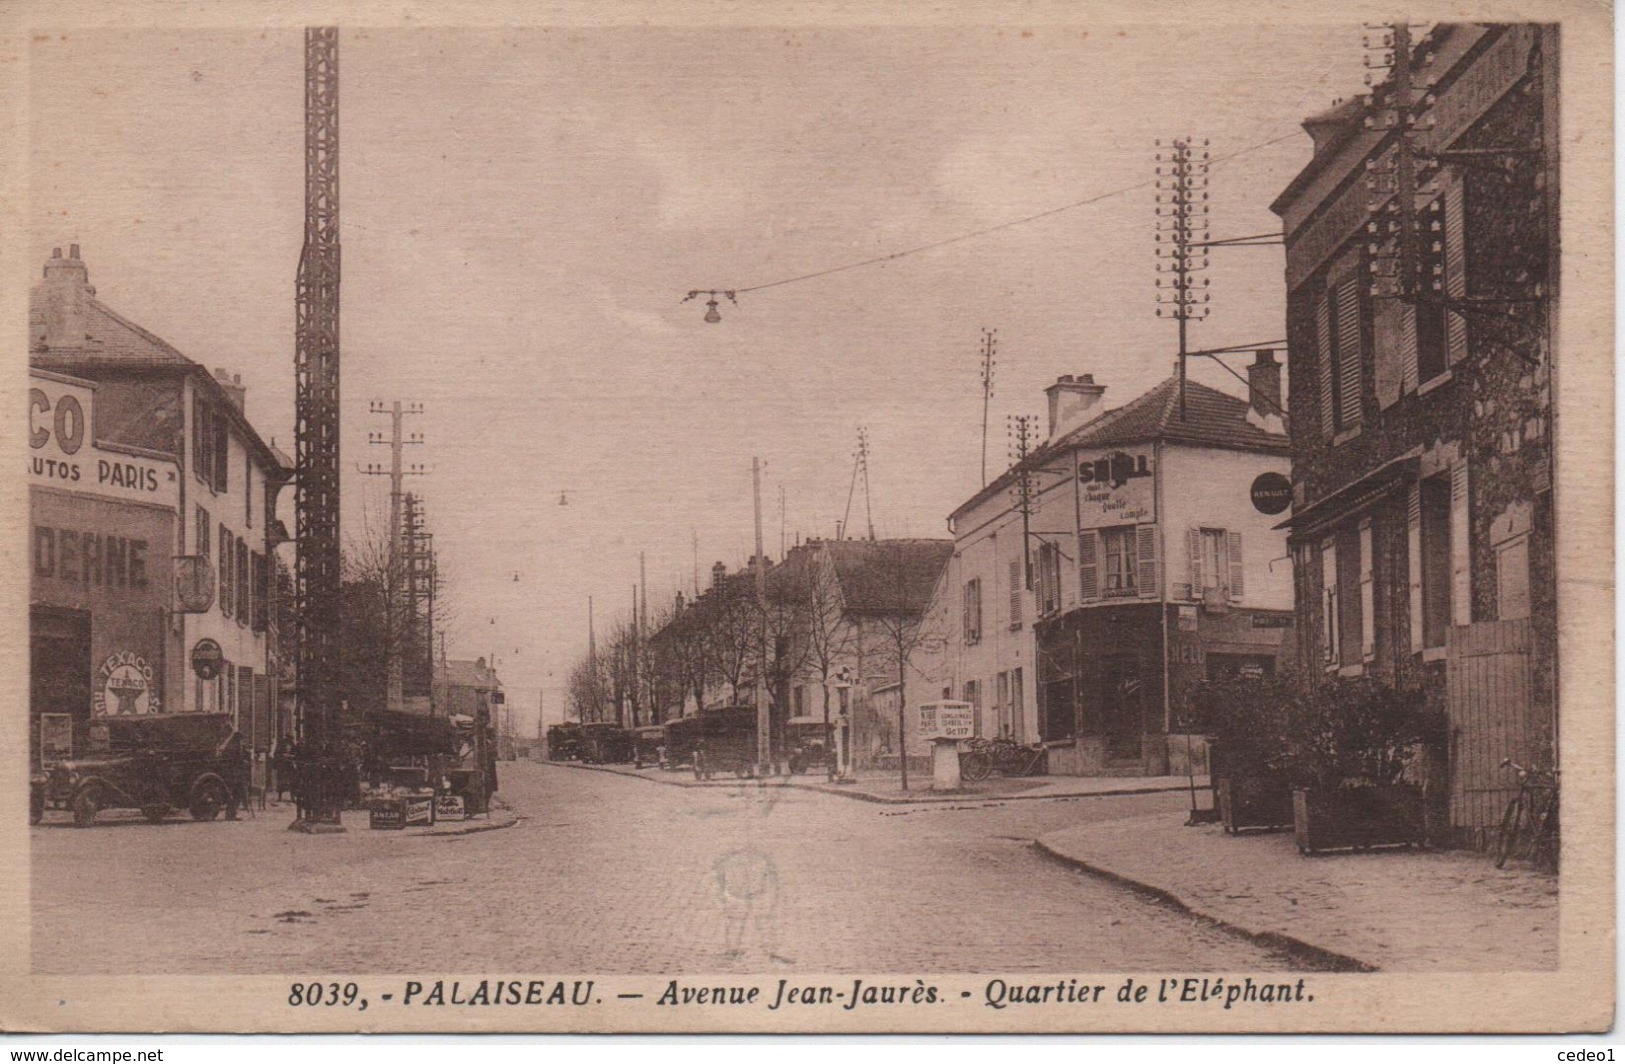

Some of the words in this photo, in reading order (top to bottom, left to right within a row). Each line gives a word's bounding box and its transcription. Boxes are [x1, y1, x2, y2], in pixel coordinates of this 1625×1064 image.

[98, 458, 159, 492] PARIS
[99, 650, 153, 681] TEXACO
[110, 678, 144, 688] TEXACO
